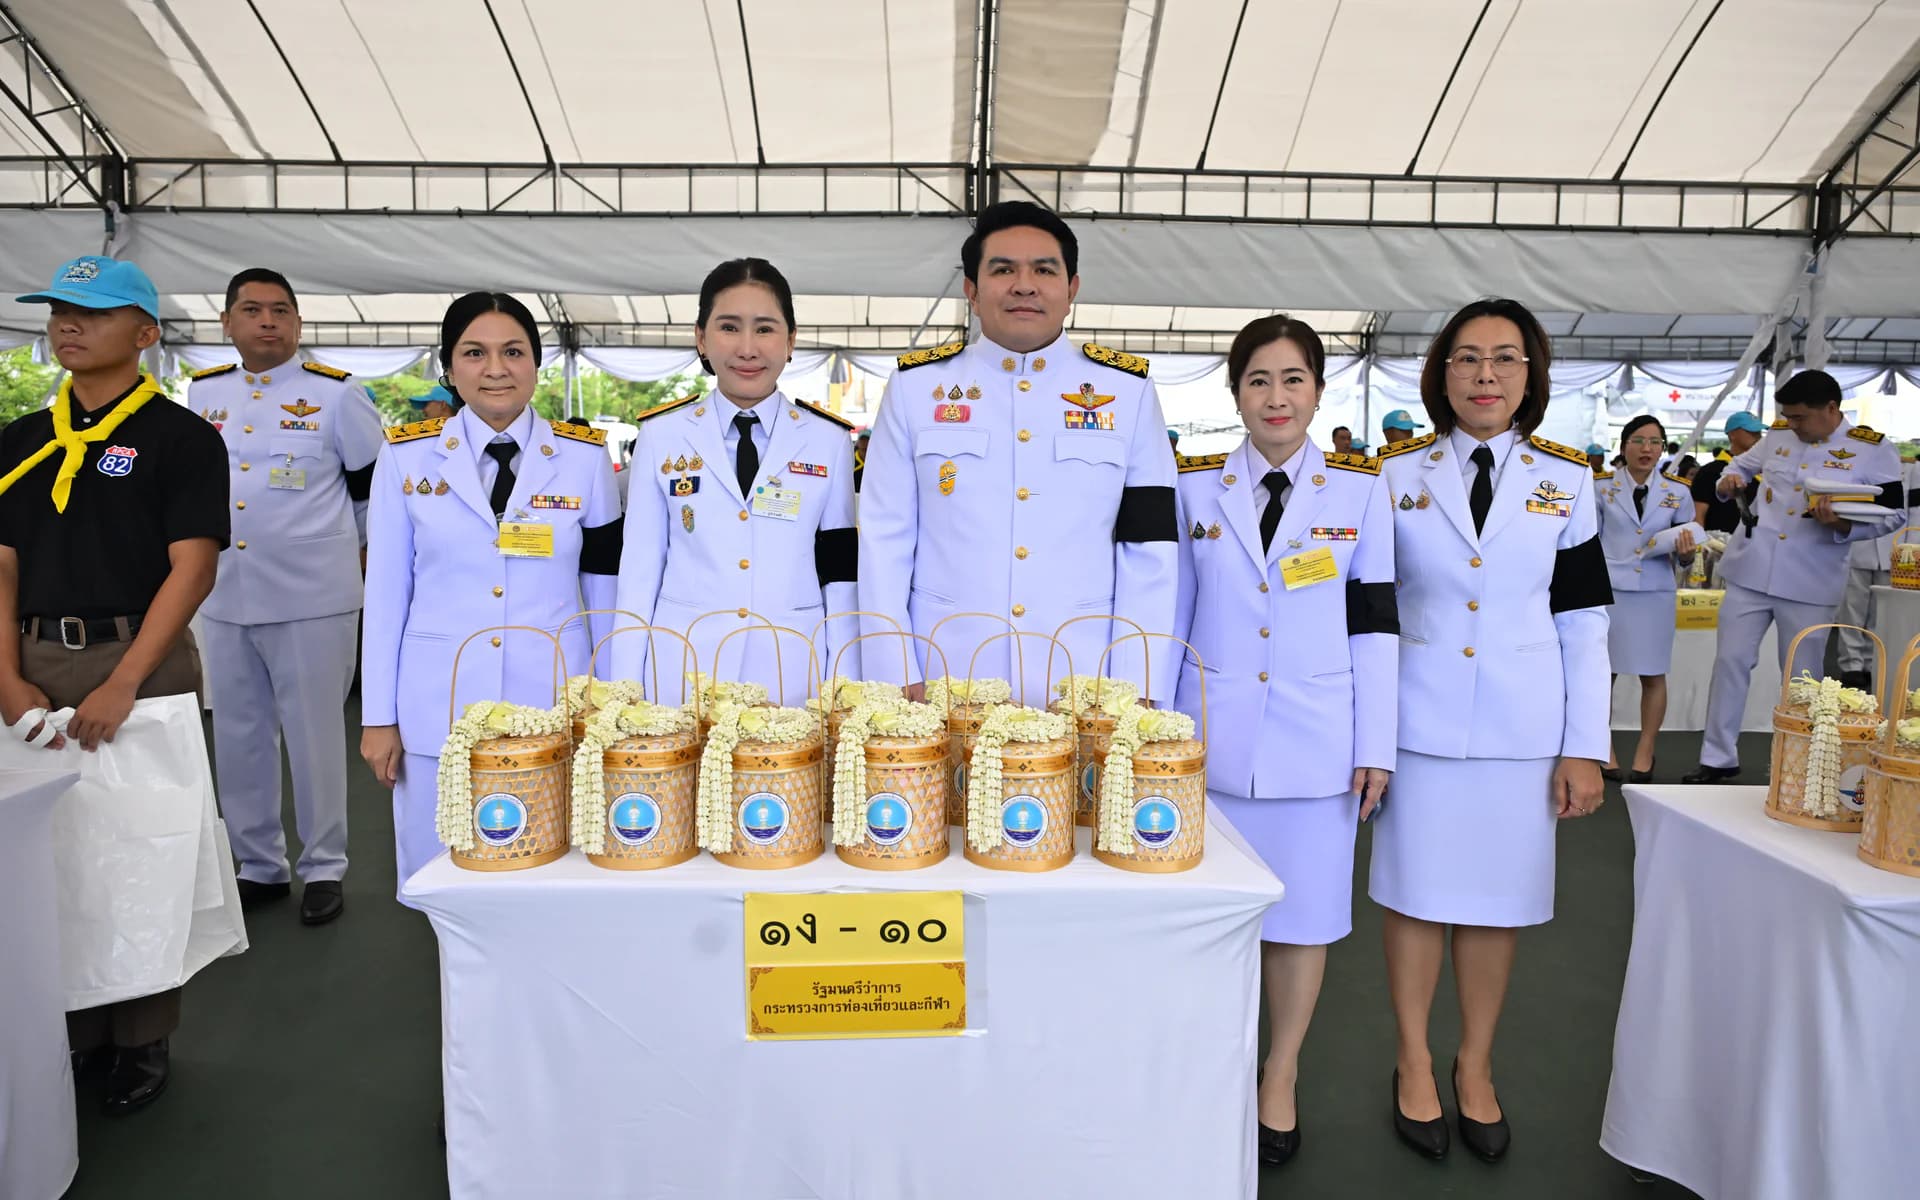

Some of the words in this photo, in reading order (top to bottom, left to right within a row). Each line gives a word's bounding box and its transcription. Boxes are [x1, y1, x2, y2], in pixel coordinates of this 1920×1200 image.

[103, 456, 129, 473] 82
[760, 913, 816, 946] ๑ง
[880, 919, 946, 944] ๑๐
[812, 979, 902, 998] รัฐมนตรีว่าการ
[763, 996, 950, 1015] กระทรวงการท่องเที่ยวและกีฬา
